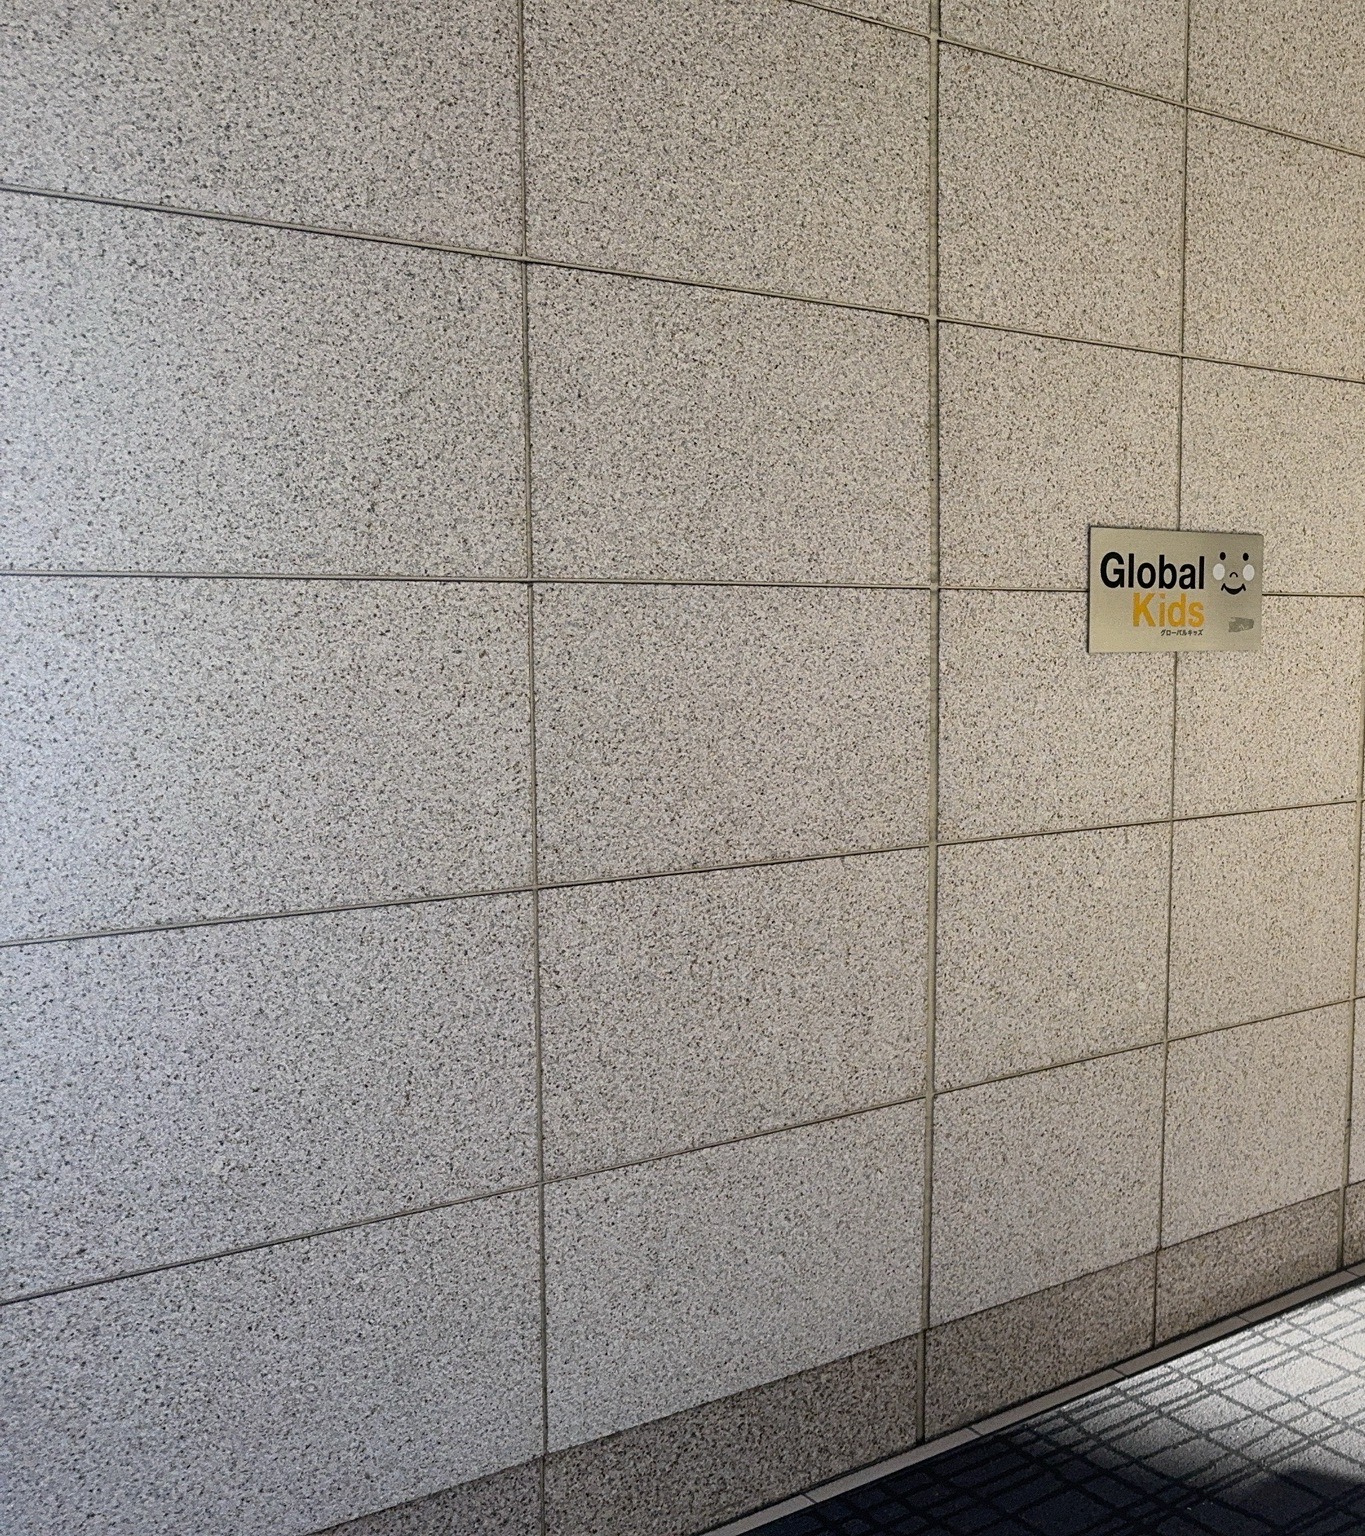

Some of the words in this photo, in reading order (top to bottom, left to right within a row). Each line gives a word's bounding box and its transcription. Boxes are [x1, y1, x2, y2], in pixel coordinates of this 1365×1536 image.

[1100, 552, 1205, 590] Global
[1132, 592, 1205, 628] Kids
[1160, 629, 1203, 637] グローバルキッズ
